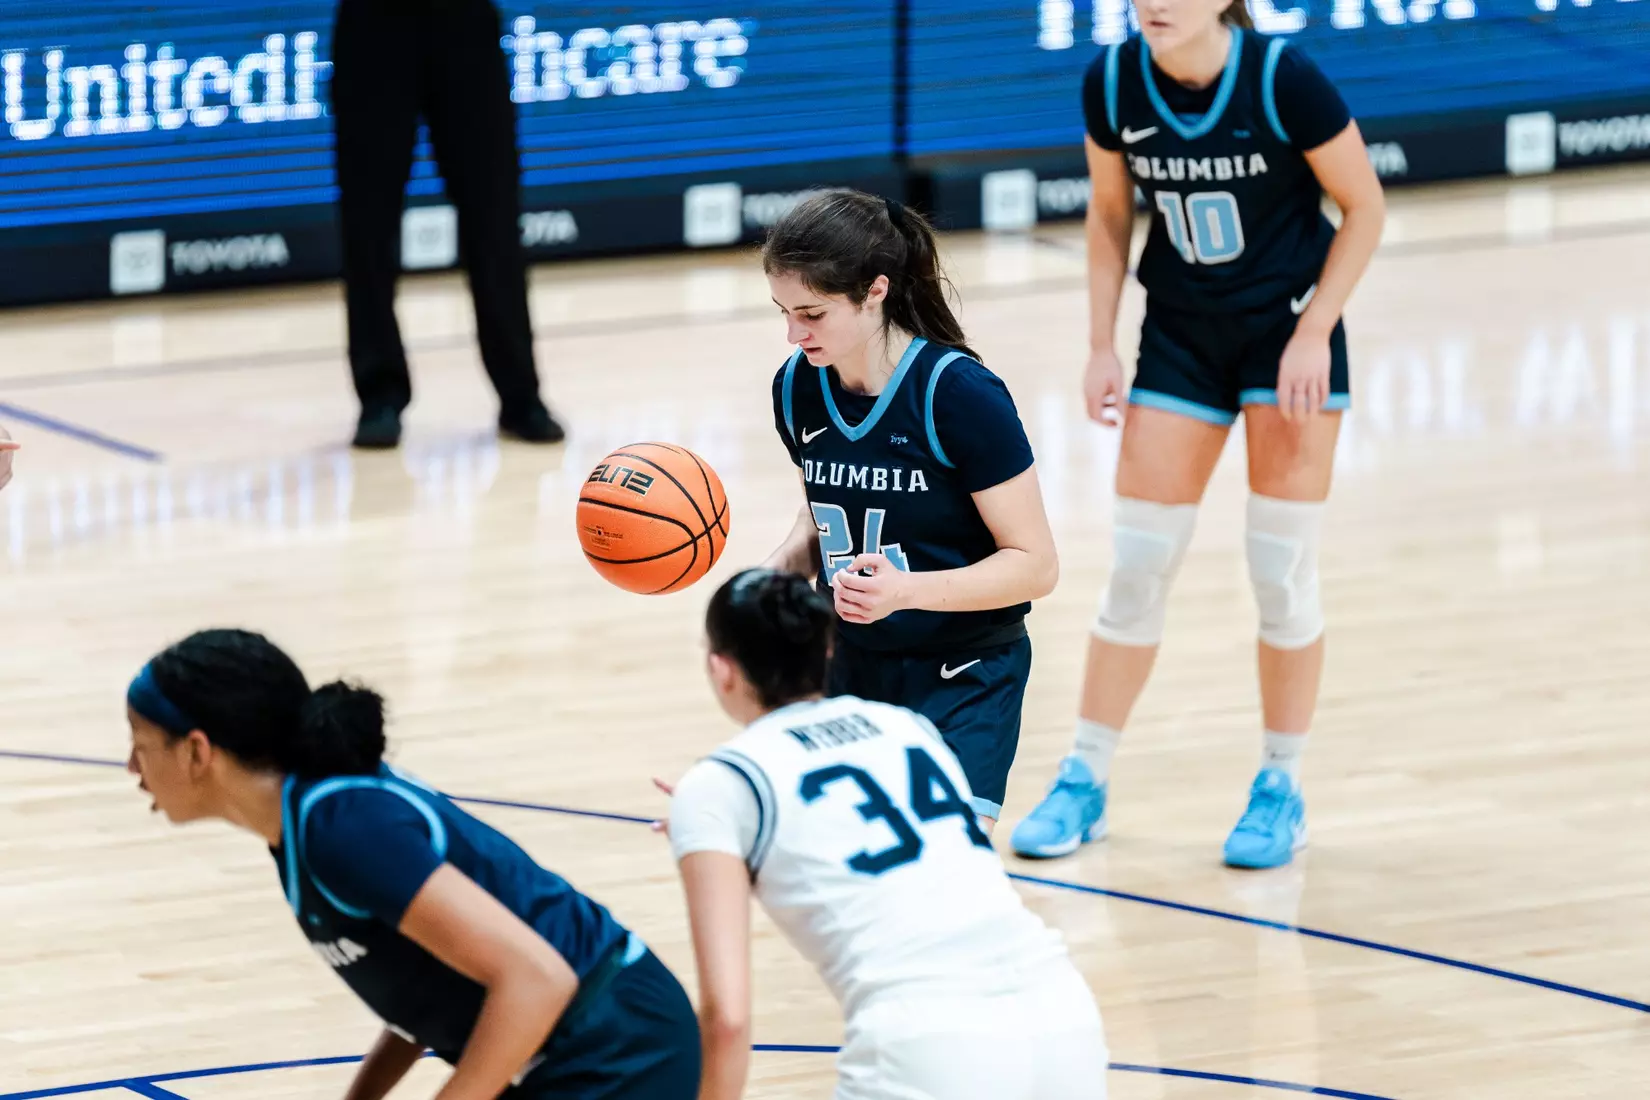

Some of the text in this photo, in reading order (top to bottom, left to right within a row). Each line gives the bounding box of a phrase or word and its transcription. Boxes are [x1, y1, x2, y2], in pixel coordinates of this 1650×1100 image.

[1154, 190, 1246, 265] 10
[170, 233, 290, 275] TOYOTA
[587, 464, 655, 497] ELITE
[801, 457, 930, 493] OLUMBIA
[797, 746, 997, 876] 34
